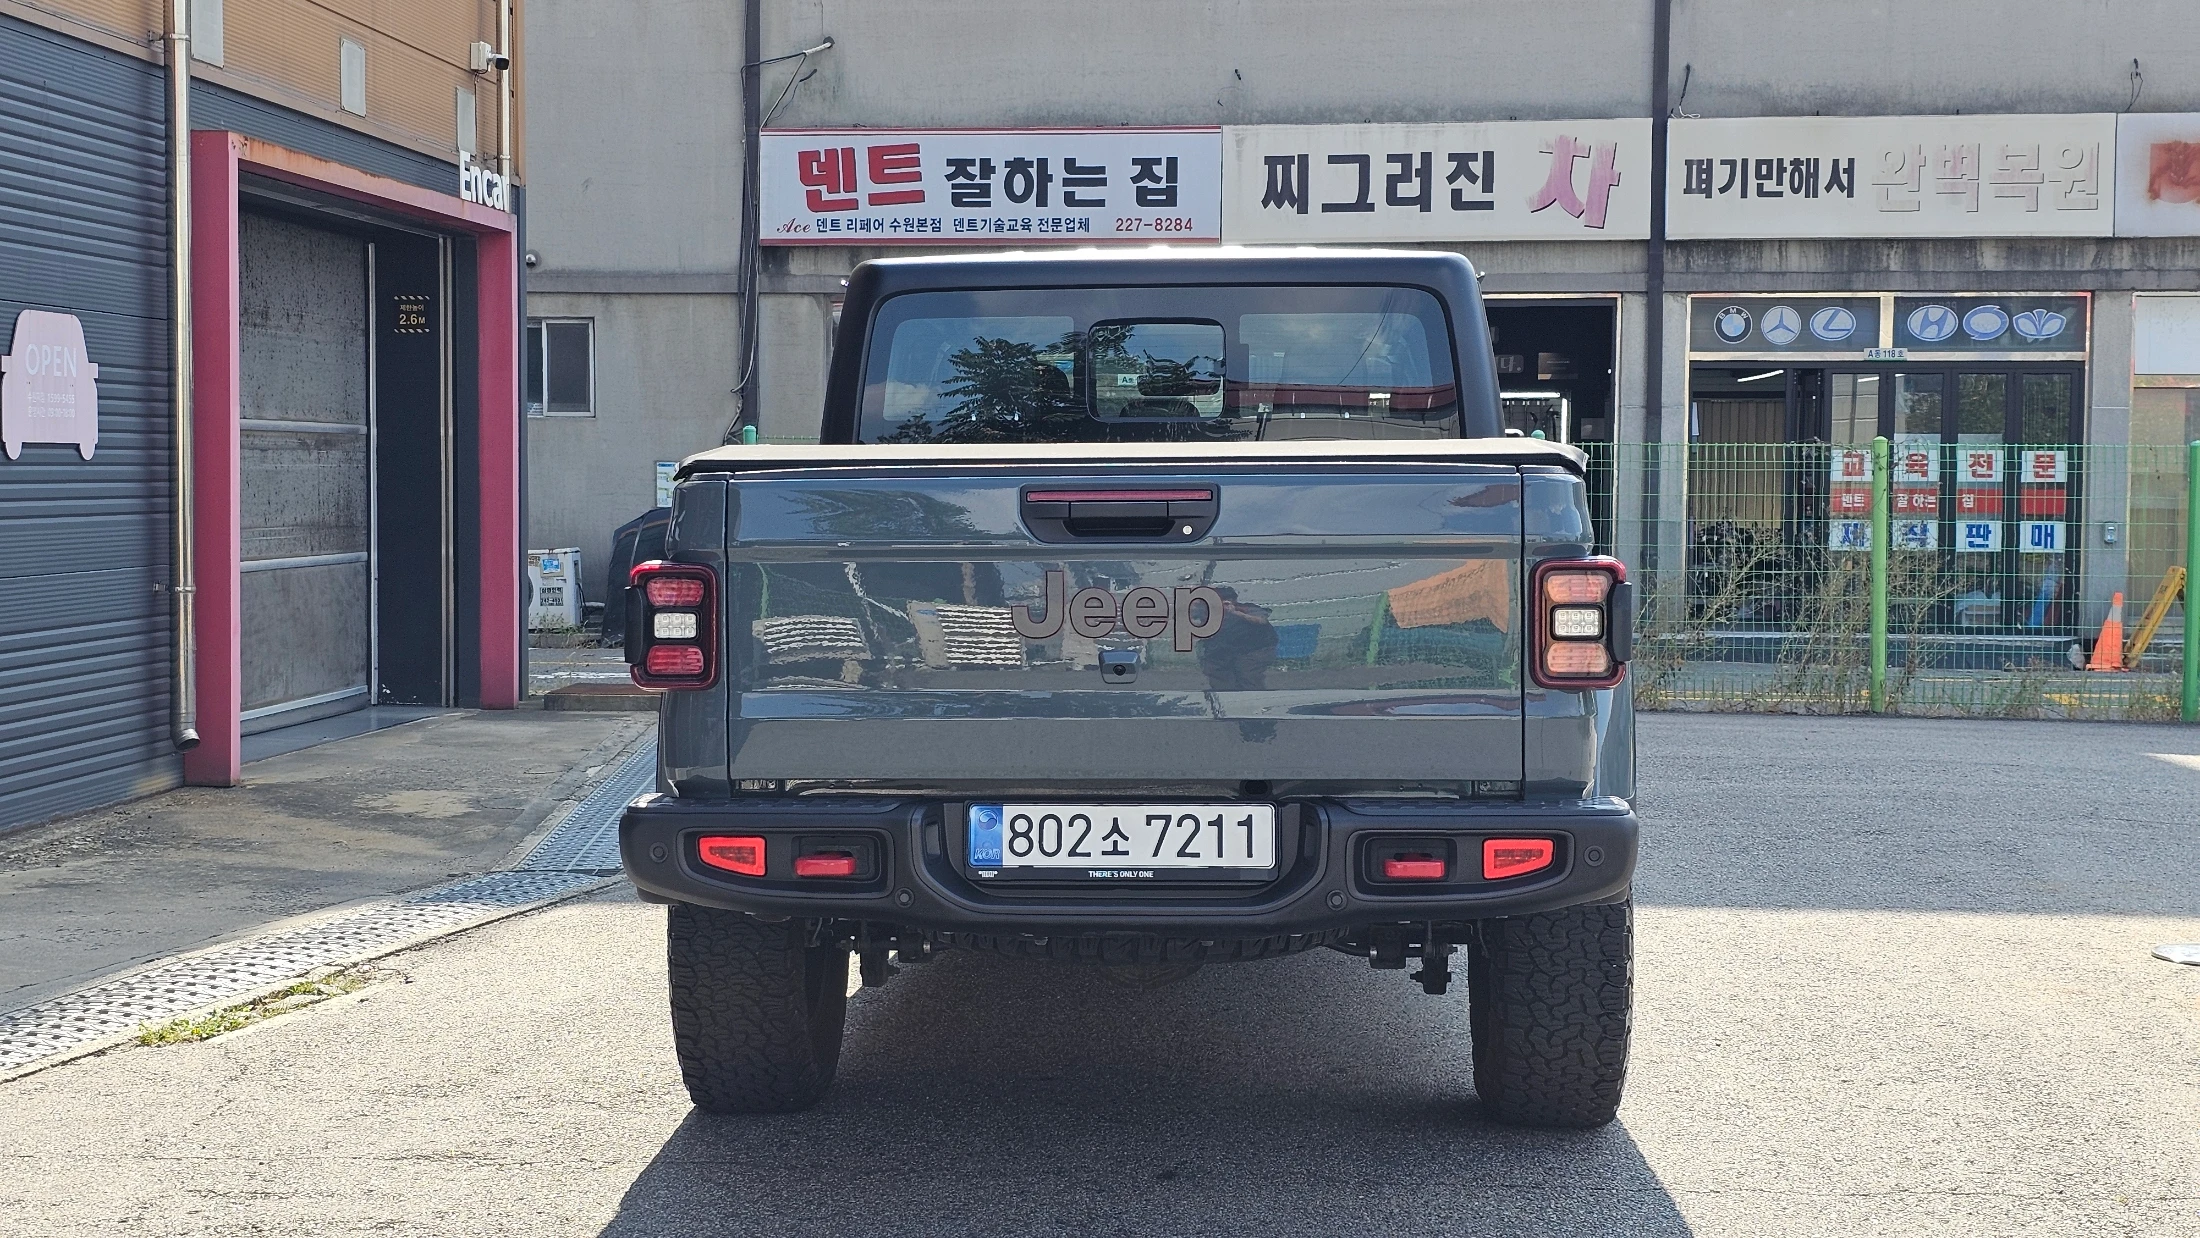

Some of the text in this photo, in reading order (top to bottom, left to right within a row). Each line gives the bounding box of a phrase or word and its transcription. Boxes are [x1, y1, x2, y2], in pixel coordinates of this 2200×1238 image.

[797, 142, 1178, 213] 덴트 잘하는 집
[1261, 134, 1621, 229] 찌그러진 차
[1683, 157, 1856, 199] 펴기만해서
[776, 217, 1194, 233] Ace 덴트 리페어 수원본점 덴트기술교육 전문업체 227-8284
[1718, 307, 1749, 320] BMW
[26, 343, 77, 378] OPEN
[1842, 493, 1865, 508] 덴트
[1010, 570, 1225, 652] Jeep
[1008, 813, 1254, 859] 802소 7211
[1088, 870, 1155, 878] THERE'S ONLY ONE
